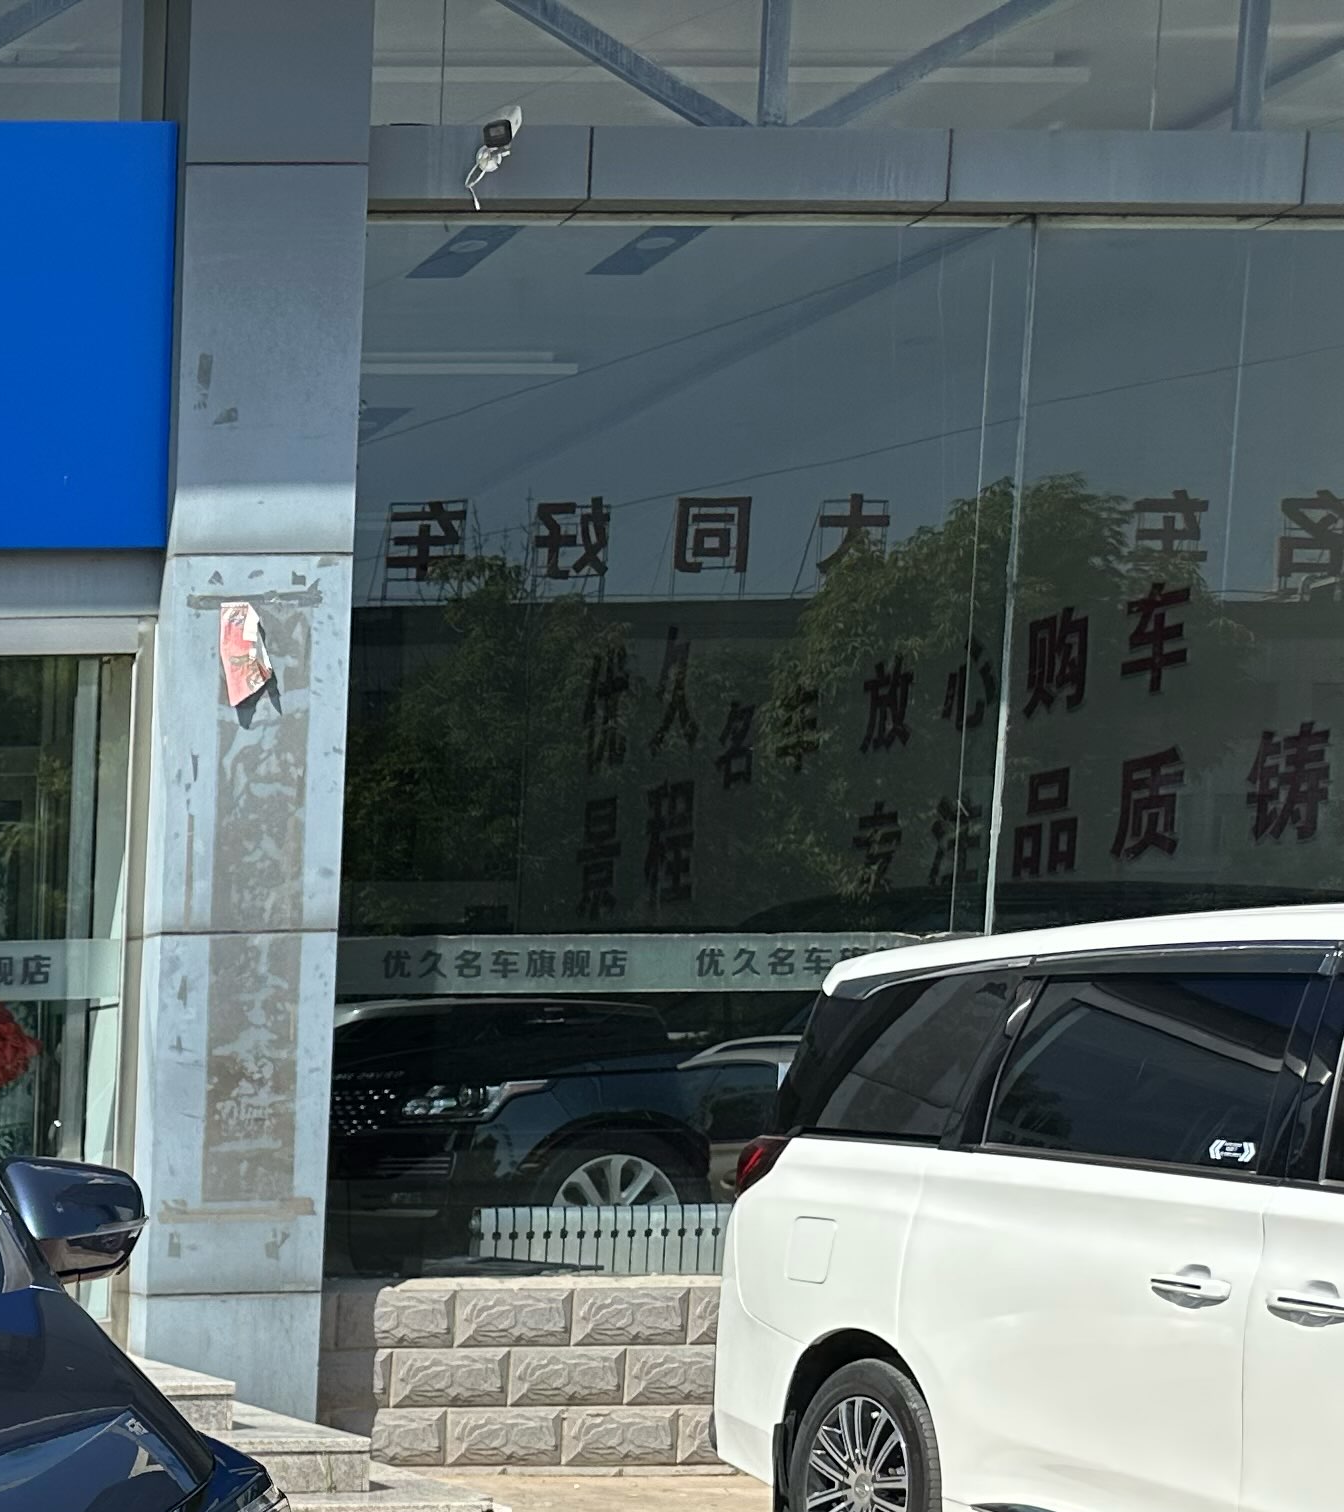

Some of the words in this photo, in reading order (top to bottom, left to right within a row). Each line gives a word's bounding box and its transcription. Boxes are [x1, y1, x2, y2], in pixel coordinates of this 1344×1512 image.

[382, 949, 628, 979] 优久名车旗舰店
[696, 947, 887, 977] 优久名车
